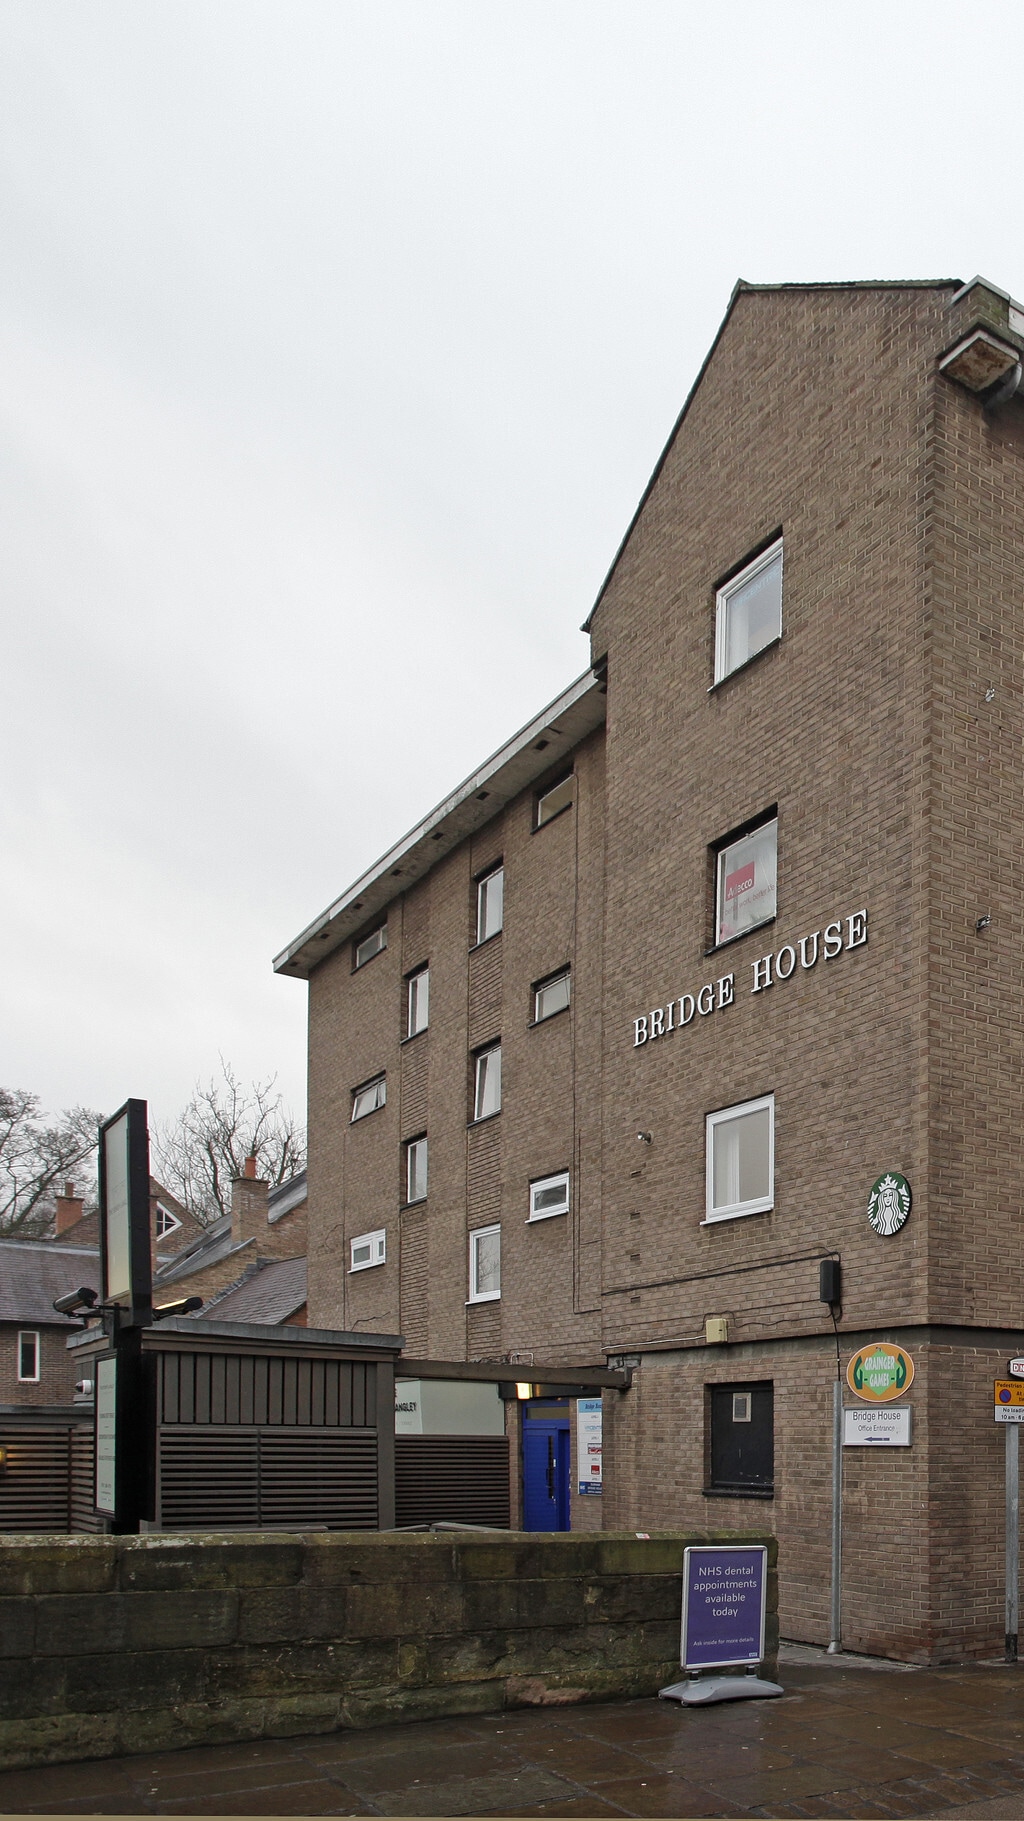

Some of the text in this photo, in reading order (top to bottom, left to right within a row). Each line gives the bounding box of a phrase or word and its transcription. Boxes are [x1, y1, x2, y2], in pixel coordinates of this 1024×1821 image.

[633, 908, 868, 1047] BRIDGE HOUSE
[864, 1355, 895, 1370] GRAINGER
[869, 1373, 890, 1387] GAMES
[852, 1411, 901, 1423] Bridge House
[858, 1424, 895, 1432] Office Entrance
[698, 1565, 754, 1576] NHS dental
[693, 1579, 757, 1592] appointments
[705, 1593, 746, 1603] available
[712, 1607, 738, 1617] today
